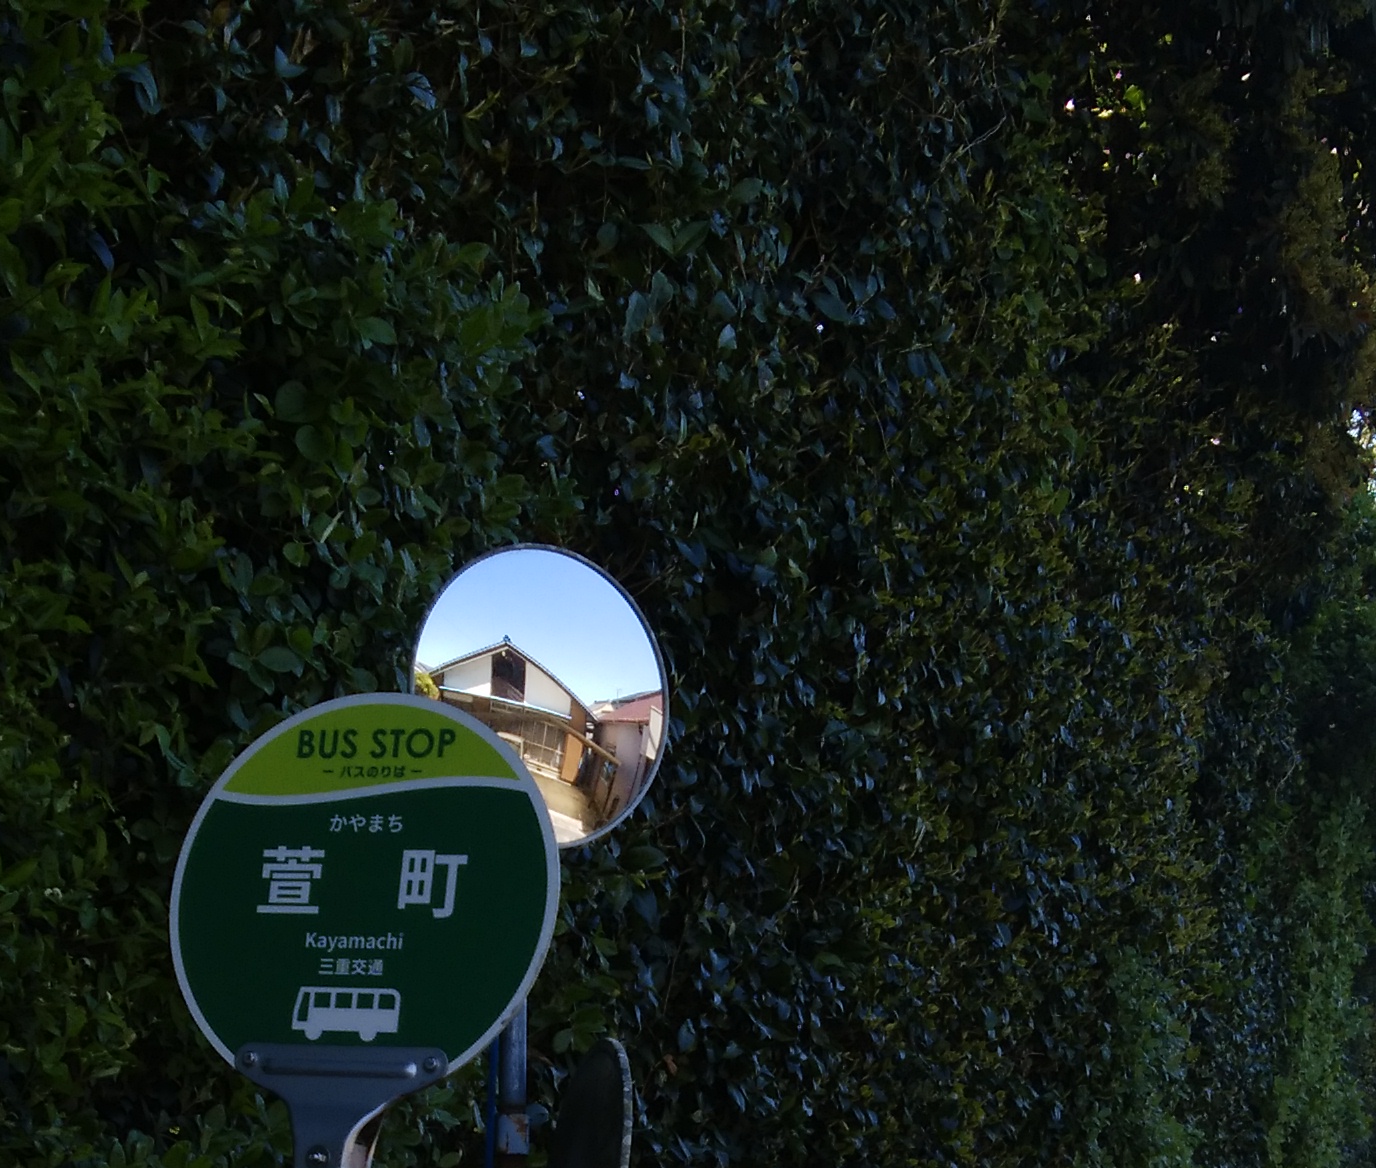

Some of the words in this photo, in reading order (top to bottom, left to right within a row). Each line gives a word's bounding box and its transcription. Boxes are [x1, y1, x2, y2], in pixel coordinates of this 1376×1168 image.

[296, 729, 358, 759] BUS
[370, 728, 457, 759] STOP
[340, 767, 405, 778] バスのりば
[329, 814, 404, 834] かやまち
[304, 932, 404, 953] Kayamachi
[318, 958, 384, 977] 三重交通
